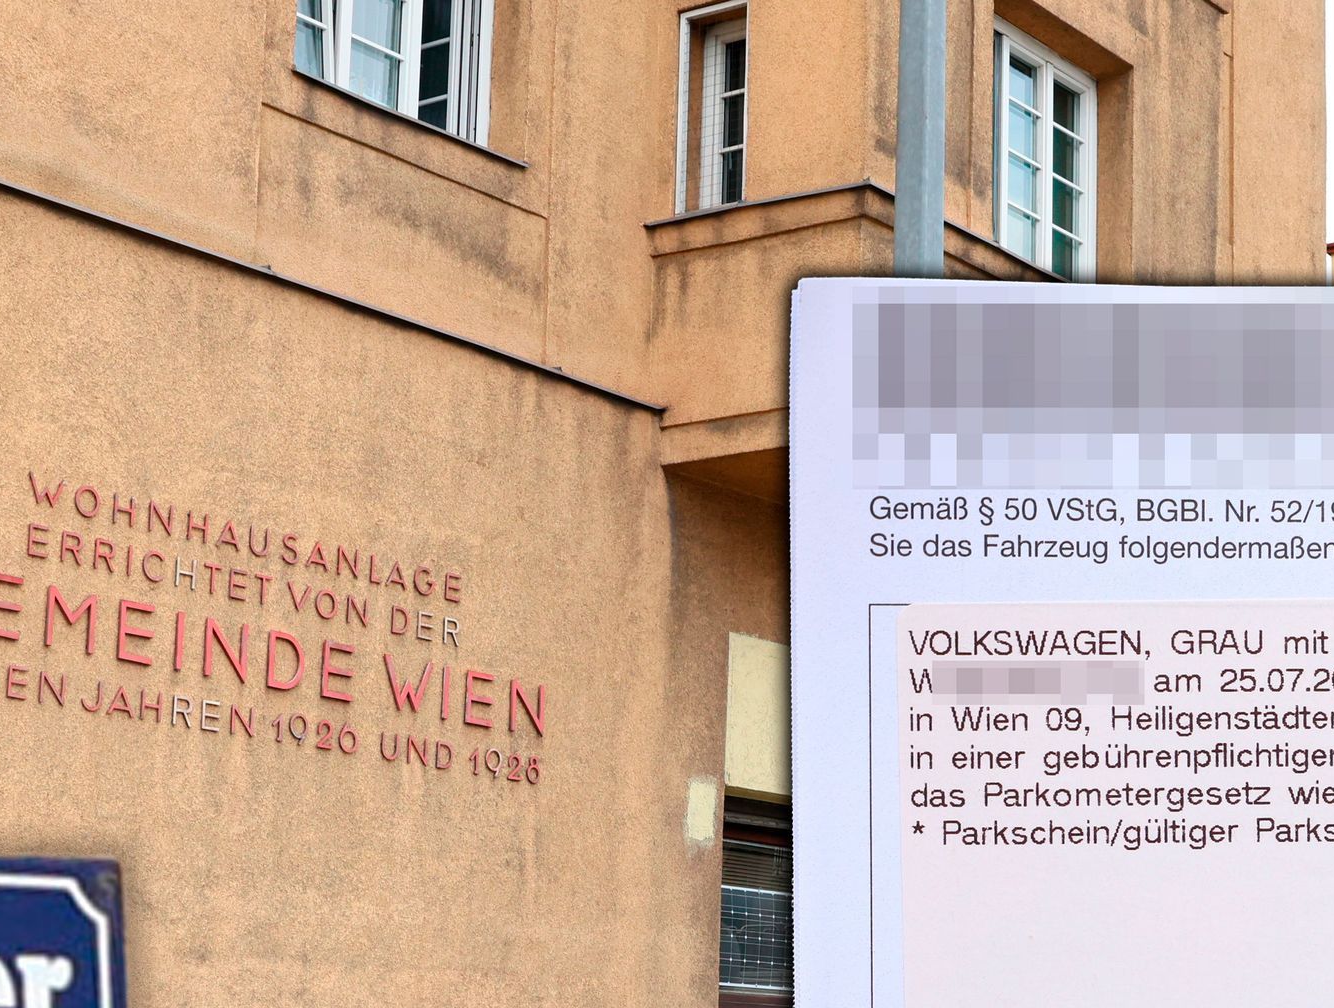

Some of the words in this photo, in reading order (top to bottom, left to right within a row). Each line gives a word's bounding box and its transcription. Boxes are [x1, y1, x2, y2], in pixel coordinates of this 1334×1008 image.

[870, 496, 968, 520] Gemäß
[979, 497, 994, 526] §
[1005, 498, 1037, 520] 50
[1047, 498, 1124, 525] VStG,
[1137, 498, 1213, 522] BGBl.
[1226, 500, 1259, 523] Nr.
[28, 471, 462, 602] WOHNHAUSANLAGE
[870, 533, 912, 557] Sie
[923, 534, 971, 558] das
[984, 535, 1107, 565] Fahrzeug
[27, 523, 272, 603] ERRICHTET
[287, 580, 369, 628] VON
[390, 604, 460, 647] DER
[909, 630, 1150, 660] VOLKSWAGEN,
[1171, 630, 1262, 655] GRAU
[1285, 630, 1328, 655] mit
[383, 653, 546, 738] WIEN
[1154, 675, 1201, 693] am
[80, 680, 256, 738] JAHREN
[271, 712, 359, 754] 1926
[380, 732, 453, 769] UND
[469, 747, 540, 784] 1928
[910, 707, 932, 732] in
[951, 707, 1028, 732] Wien
[1046, 708, 1089, 737] 09,
[911, 745, 933, 770] in
[952, 745, 1025, 770] einer
[911, 783, 965, 808] das
[985, 782, 1270, 813] Parkometergesetz
[943, 819, 1238, 851] Parkschein/gültiger
